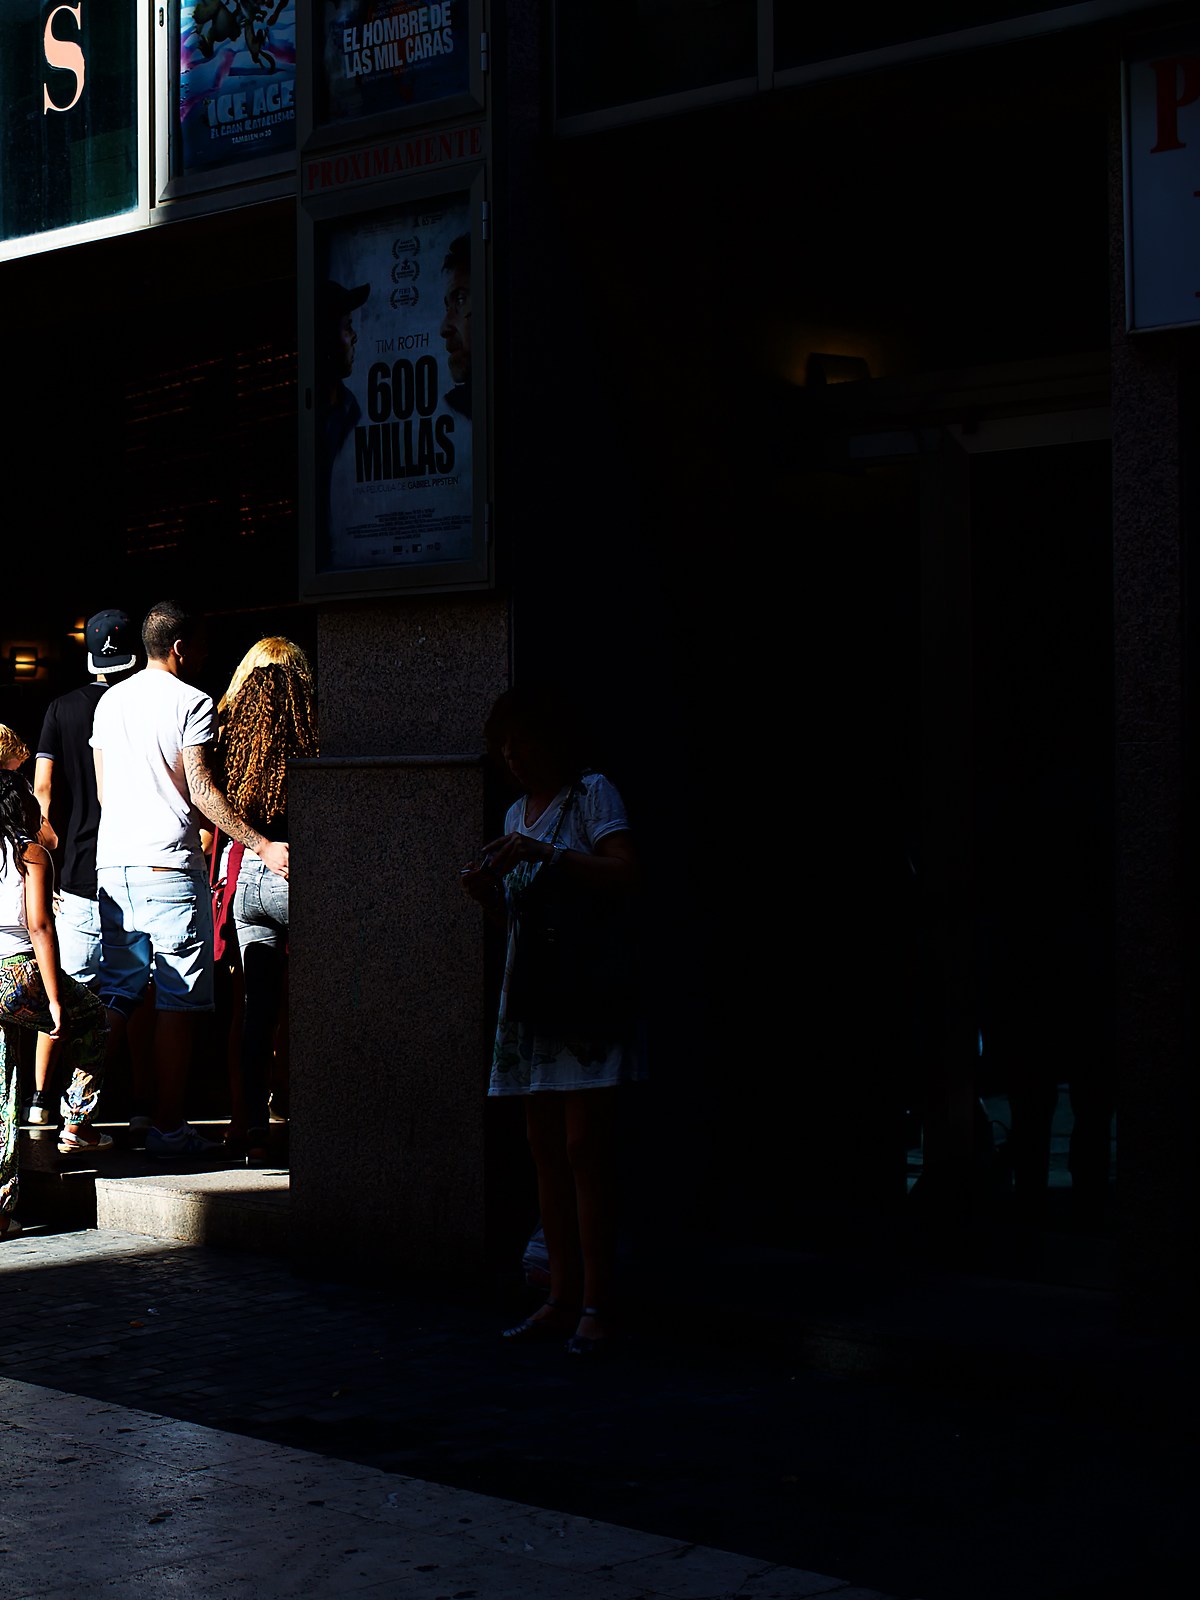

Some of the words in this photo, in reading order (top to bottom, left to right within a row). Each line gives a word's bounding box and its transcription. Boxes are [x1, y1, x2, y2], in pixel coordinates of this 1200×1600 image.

[343, 27, 360, 53] EL
[363, 6, 429, 47] HOMBRE
[430, 1, 452, 30] DE
[344, 49, 373, 79] LAS
[375, 42, 403, 71] MIL
[405, 27, 454, 63] CARAS
[43, 2, 86, 115] S
[207, 92, 248, 127] ICE
[253, 79, 295, 116] AGE
[307, 126, 482, 191] PROXIMAMENTE
[375, 338, 394, 354] TIM
[398, 332, 429, 351] ROTH
[367, 354, 438, 422] 600
[354, 414, 456, 483] MILLAS
[407, 479, 431, 490] GABRIEL
